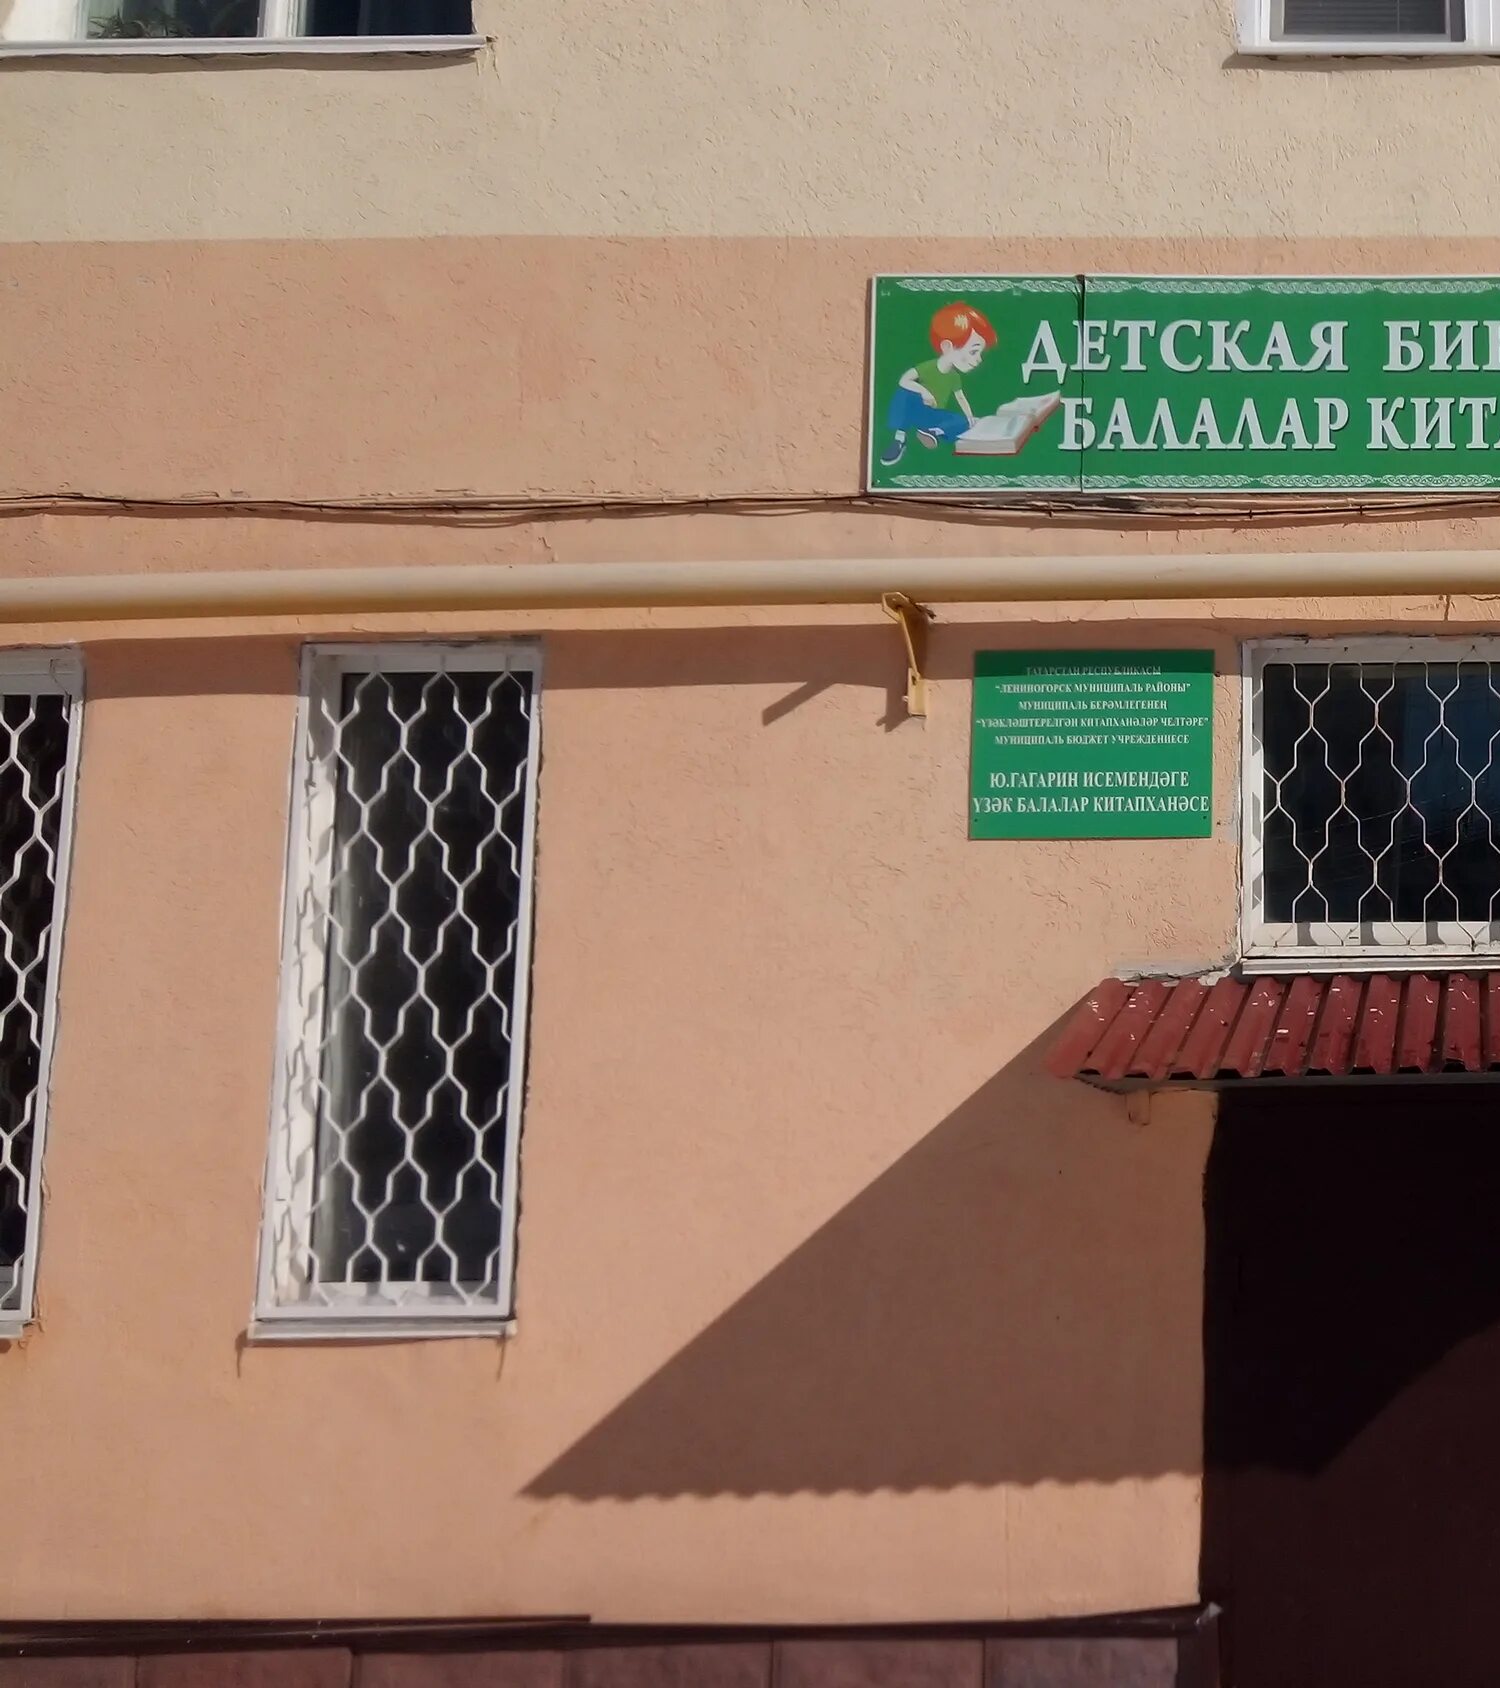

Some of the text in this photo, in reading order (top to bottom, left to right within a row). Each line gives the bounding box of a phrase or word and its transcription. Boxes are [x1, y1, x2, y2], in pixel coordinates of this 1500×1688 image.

[1021, 319, 1350, 384] ДЕТСКАЯ
[1057, 397, 1350, 451] БАЛАЛАР
[1074, 683, 1144, 693] МУНИЦИПАЛЬ
[1018, 700, 1088, 711] МУНИЦИПАЛЬ
[994, 734, 1190, 745] МУНИЦИПАЛЬ БЮДЖЕТ УЧРЕЖДЕНИЕСЕ
[989, 771, 1190, 789] Ю.ГАГАРИН ИСЕМЕНДӘГЕ
[1016, 797, 1089, 813] БАЛАЛАР
[1093, 796, 1210, 812] КИТАПХАНӘСЕ
